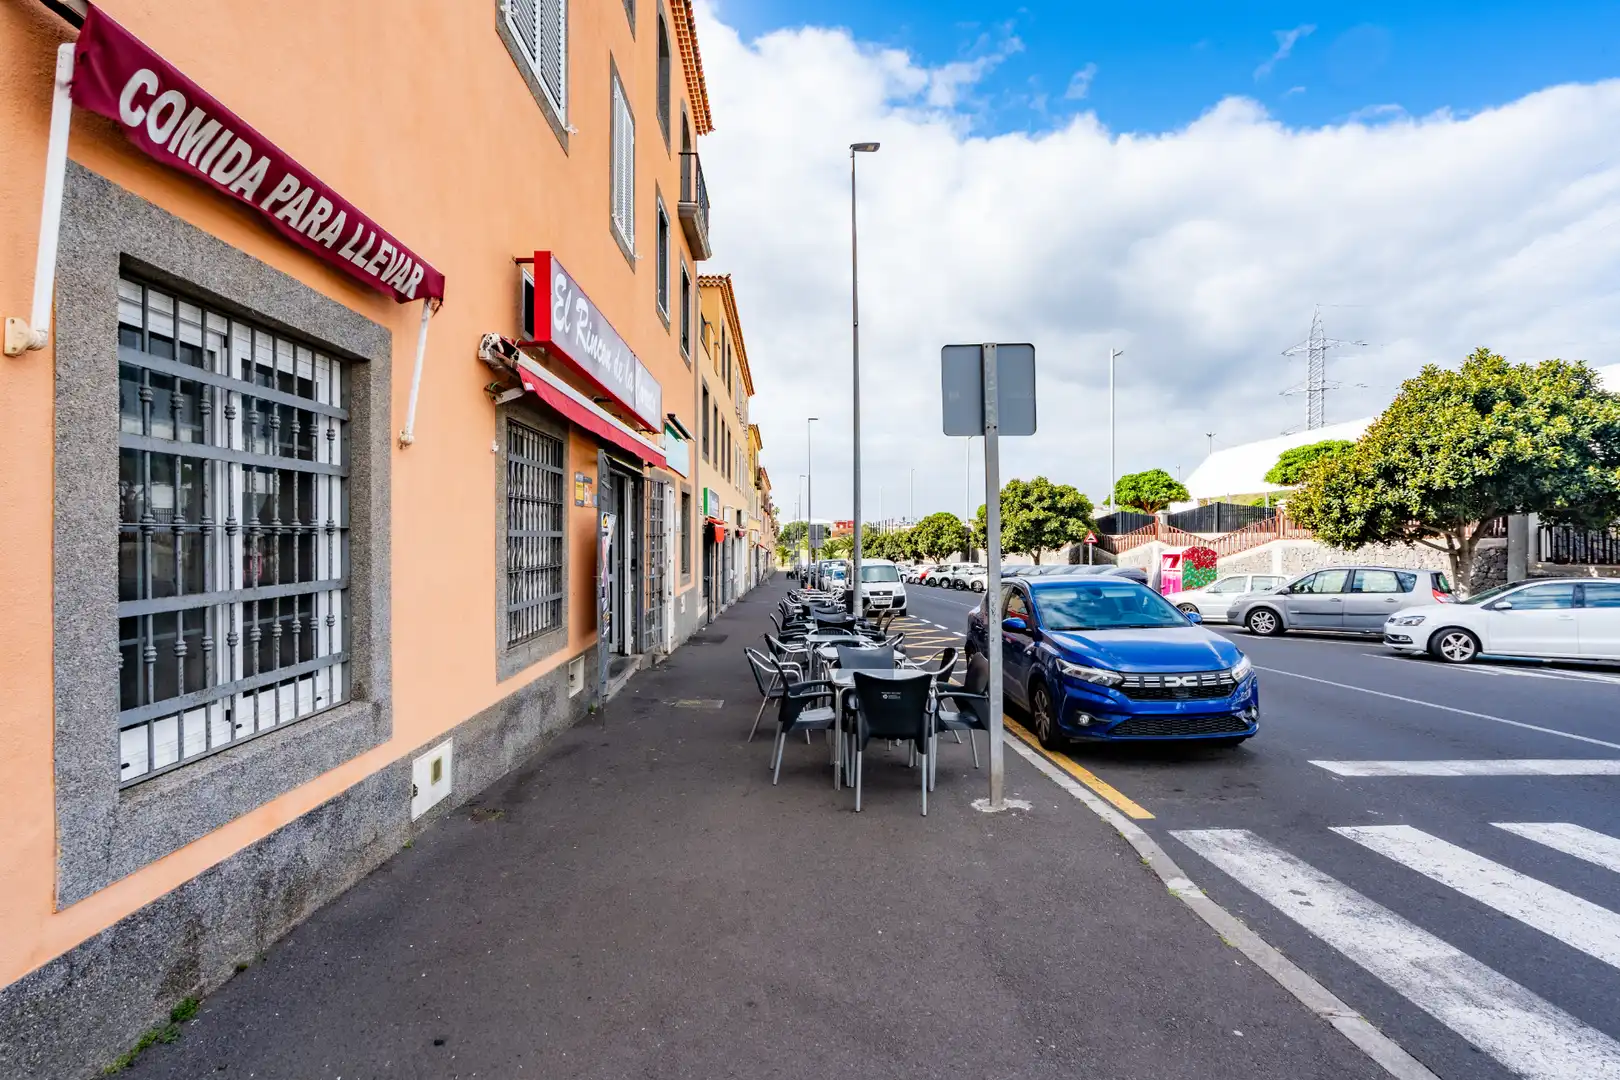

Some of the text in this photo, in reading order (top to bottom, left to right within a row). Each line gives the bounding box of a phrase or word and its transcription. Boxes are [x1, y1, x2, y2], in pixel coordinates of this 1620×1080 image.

[119, 68, 425, 300] COMIDA PARA LLEVAR
[553, 272, 572, 334] El
[613, 347, 624, 384] de
[625, 355, 635, 393] la
